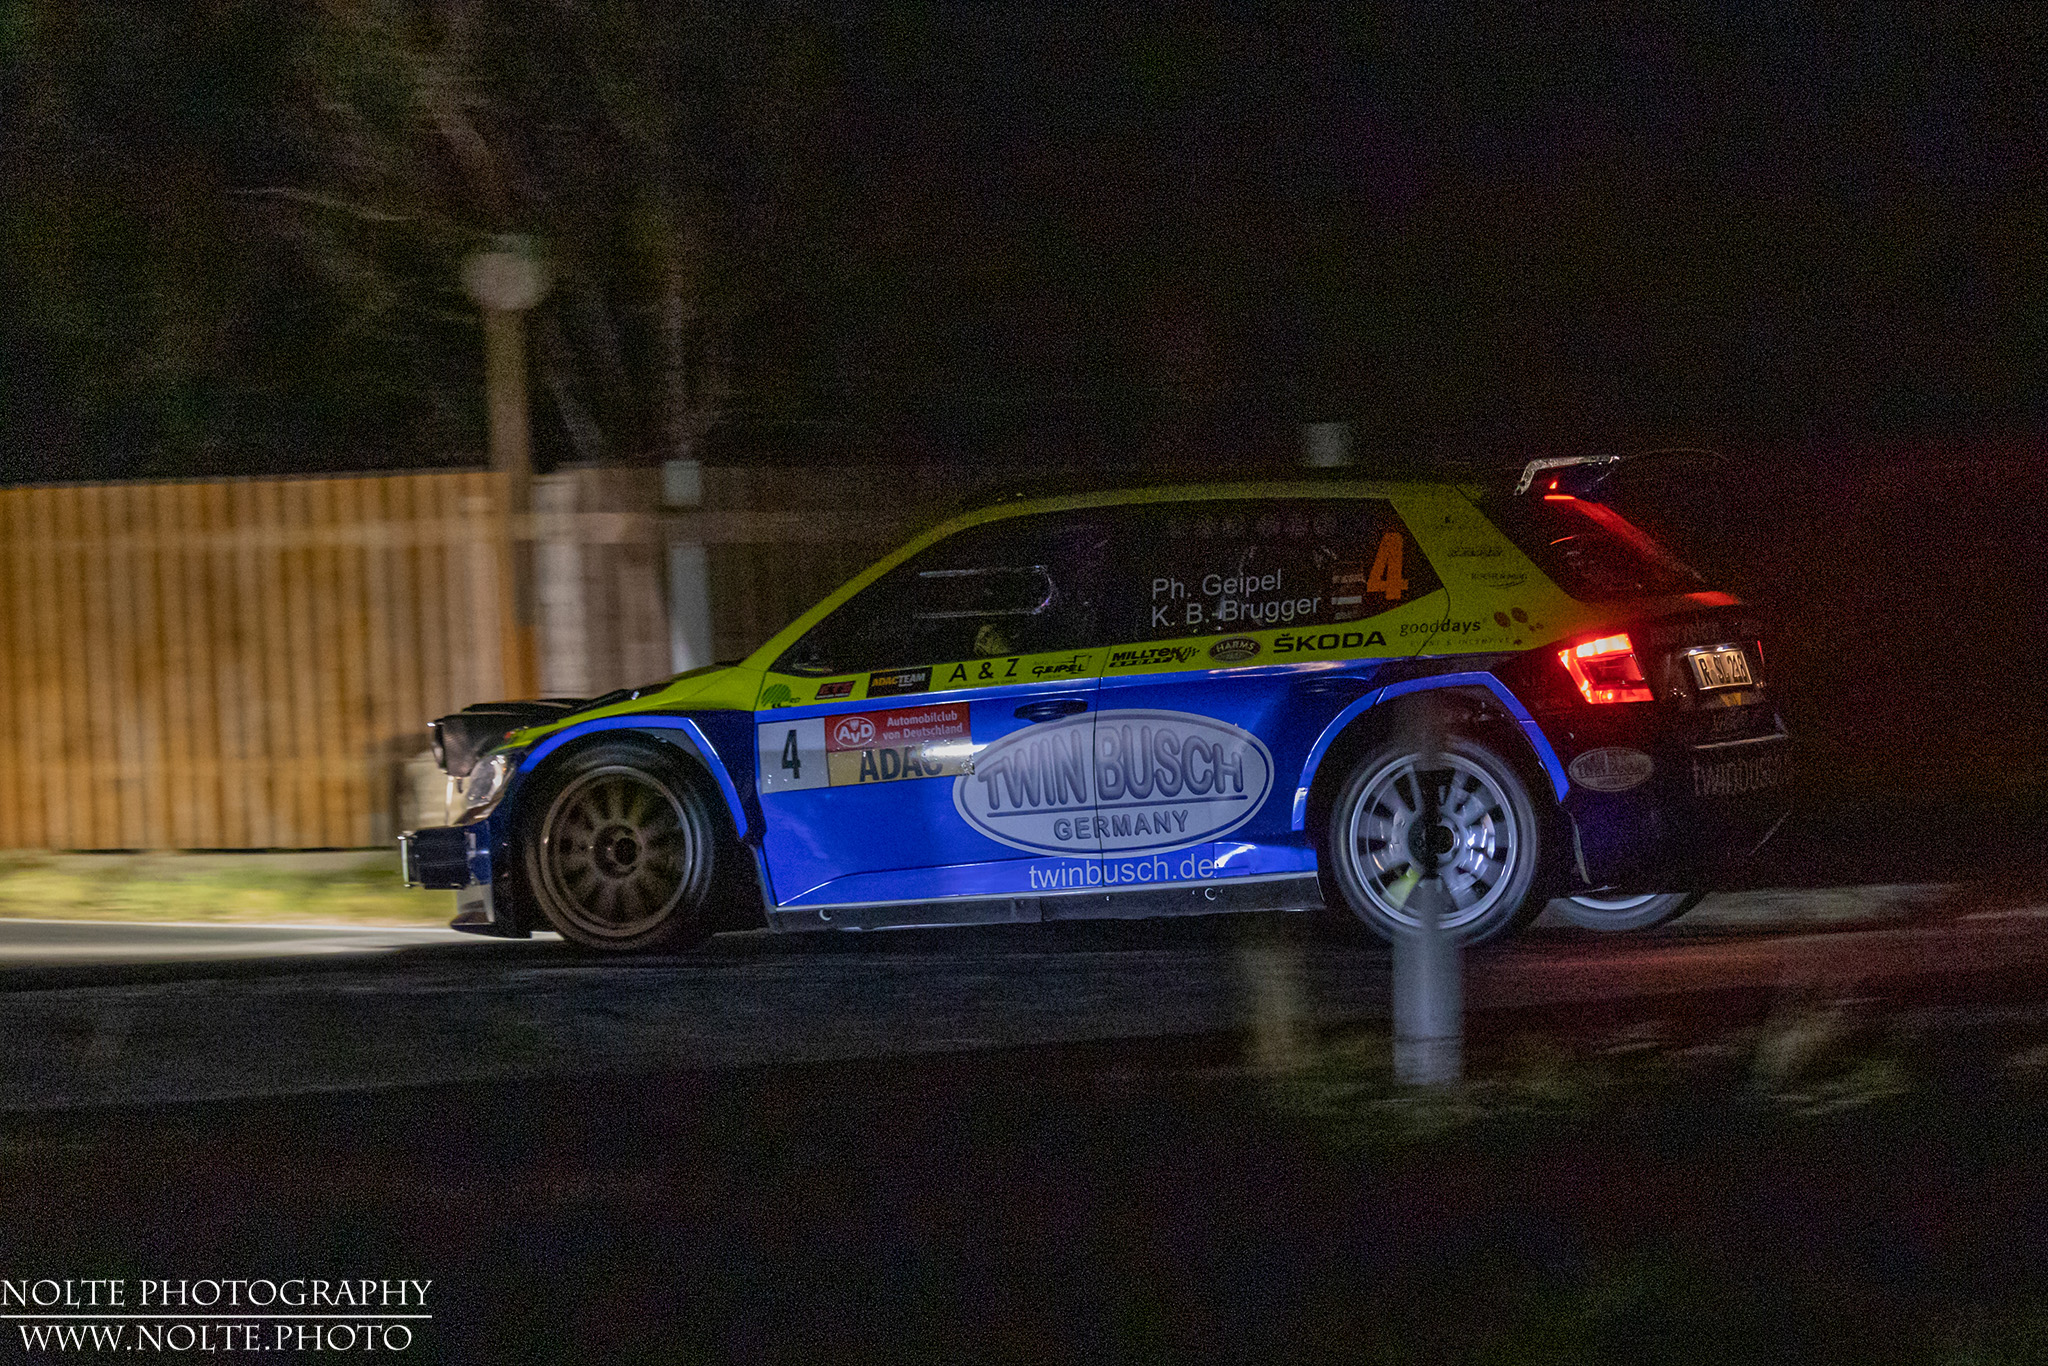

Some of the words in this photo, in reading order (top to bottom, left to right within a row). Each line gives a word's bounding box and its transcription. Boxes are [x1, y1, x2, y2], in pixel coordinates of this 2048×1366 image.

[1367, 531, 1409, 600] 4
[1152, 577, 1192, 600] Ph.
[1202, 568, 1282, 598] Geipel
[1152, 605, 1175, 628] K.
[1399, 619, 1481, 637] gooddays
[1215, 640, 1256, 653] HARMS
[1273, 631, 1387, 653] ŠKODA
[948, 663, 968, 683] A
[978, 661, 994, 680] &
[1005, 657, 1020, 677] Z
[1031, 663, 1087, 678] GEIPEL
[886, 711, 958, 727] Automobilclub
[882, 731, 901, 741] von
[903, 723, 963, 738] Deutschland
[781, 729, 801, 780] 4
[978, 728, 1087, 811] TWIN
[1099, 724, 1245, 801] BUSCH
[1054, 809, 1188, 841] GERMANY
[1029, 853, 1214, 889] twinbusch.de
